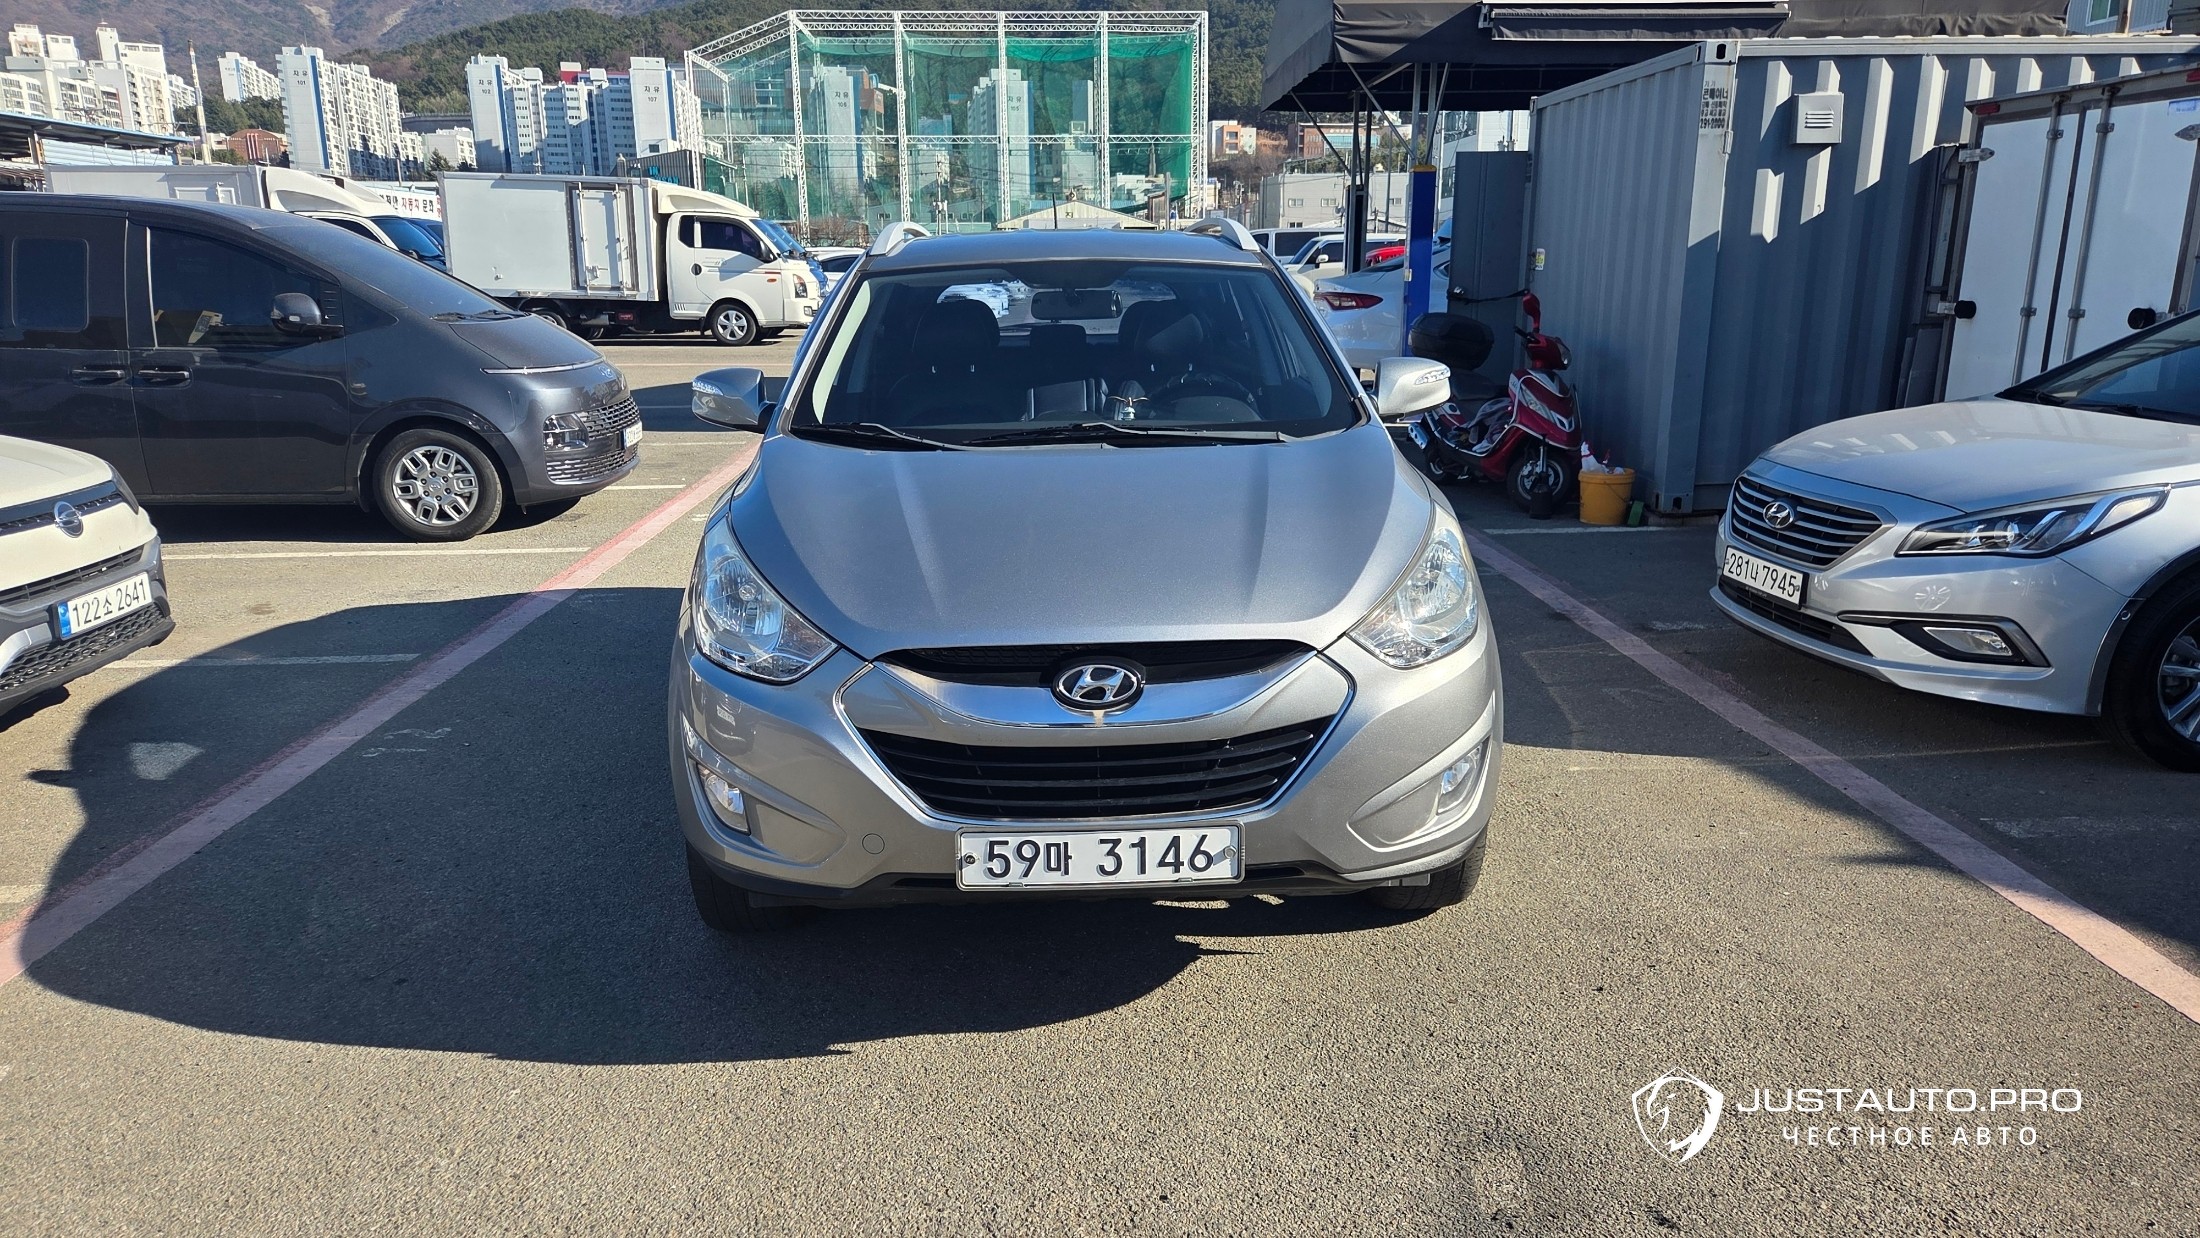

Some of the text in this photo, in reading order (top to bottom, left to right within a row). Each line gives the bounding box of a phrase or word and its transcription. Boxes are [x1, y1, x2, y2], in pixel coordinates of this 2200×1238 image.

[423, 199, 434, 213] 문화
[1728, 552, 1797, 598] 281나 7945
[72, 578, 146, 627] 122소 2641
[986, 834, 1214, 879] 59마 3146
